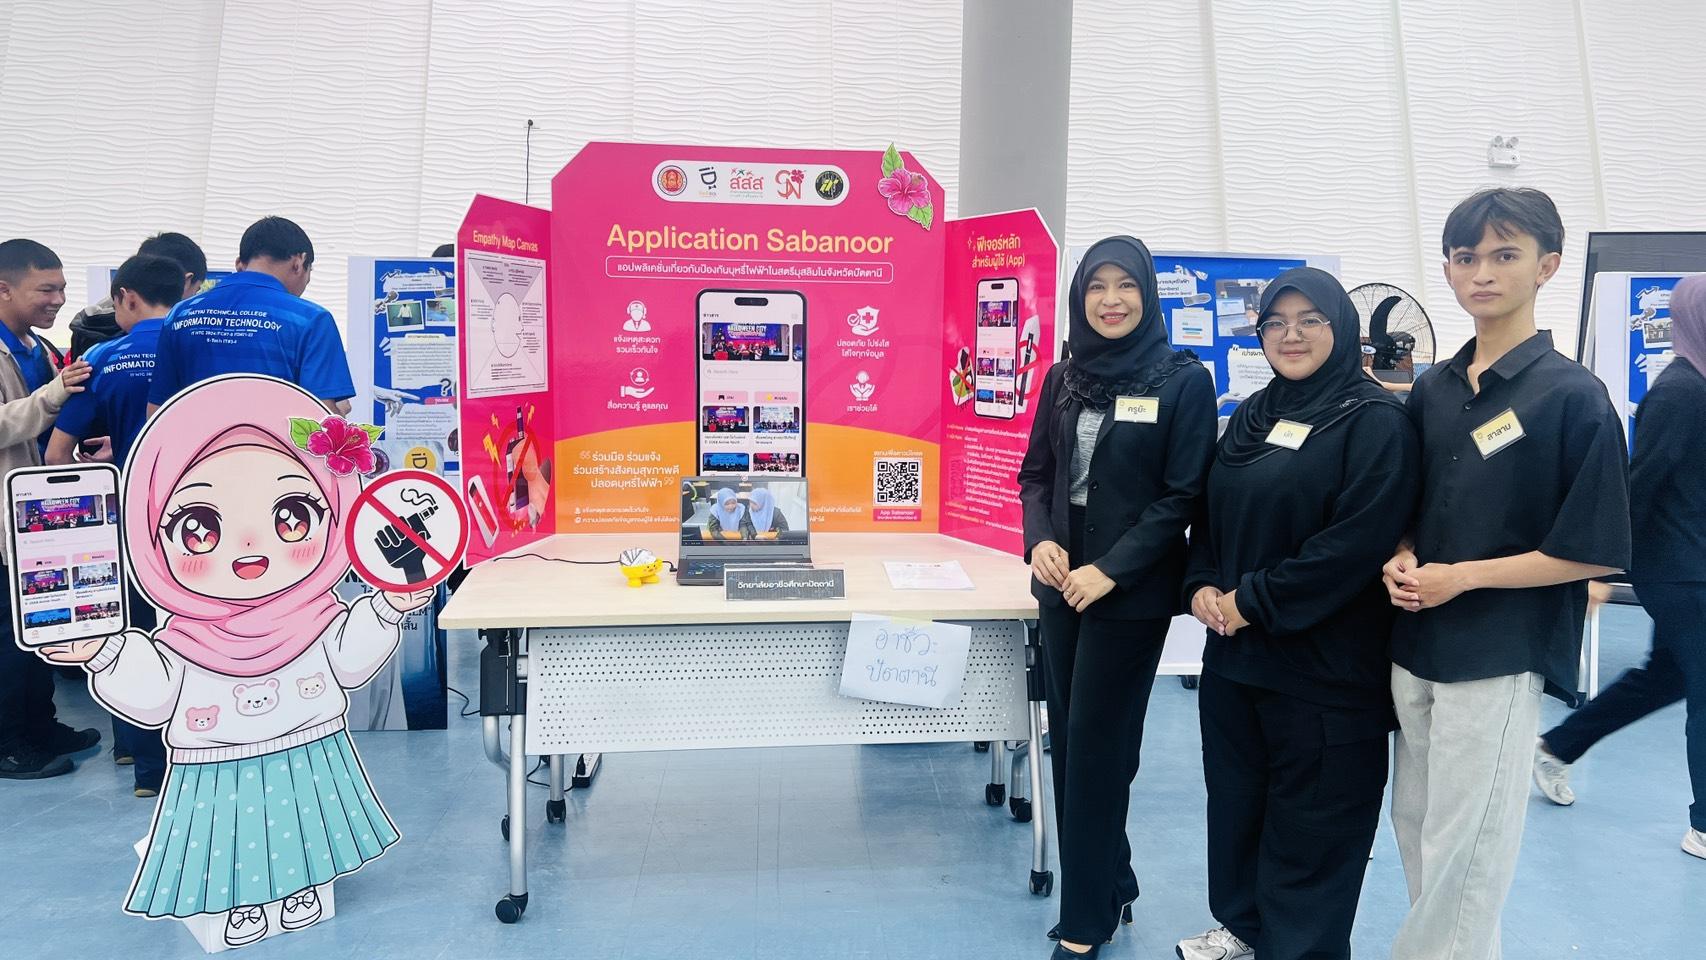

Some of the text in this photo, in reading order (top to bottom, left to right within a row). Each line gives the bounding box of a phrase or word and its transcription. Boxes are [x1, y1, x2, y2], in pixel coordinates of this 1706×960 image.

[473, 230, 538, 252] Empathy Map Canvas
[606, 224, 894, 255] Application Sabanoor
[977, 233, 1021, 252] ฟีเจอร์หลัก
[972, 252, 1026, 271] สำหรับผู้ใช้ (App)
[206, 308, 239, 316] TECHNICAL
[172, 317, 282, 332] INFORMATION TECHNOLOGY
[837, 339, 890, 348] ปลอดภัย โปร่งใส
[592, 451, 661, 462] ร่วมมือ ร่วมแจ้ง
[573, 464, 680, 477] ร่วมสร้างสังคมสุขภาพดี
[591, 476, 663, 490] ปลอดบุหรี่ไฟฟ้า
[737, 579, 835, 589] วิทยาลัยอาชีวศึกษาปัตตานี
[875, 626, 938, 656] อาชีวะ
[865, 659, 939, 687] ปัตตานี
